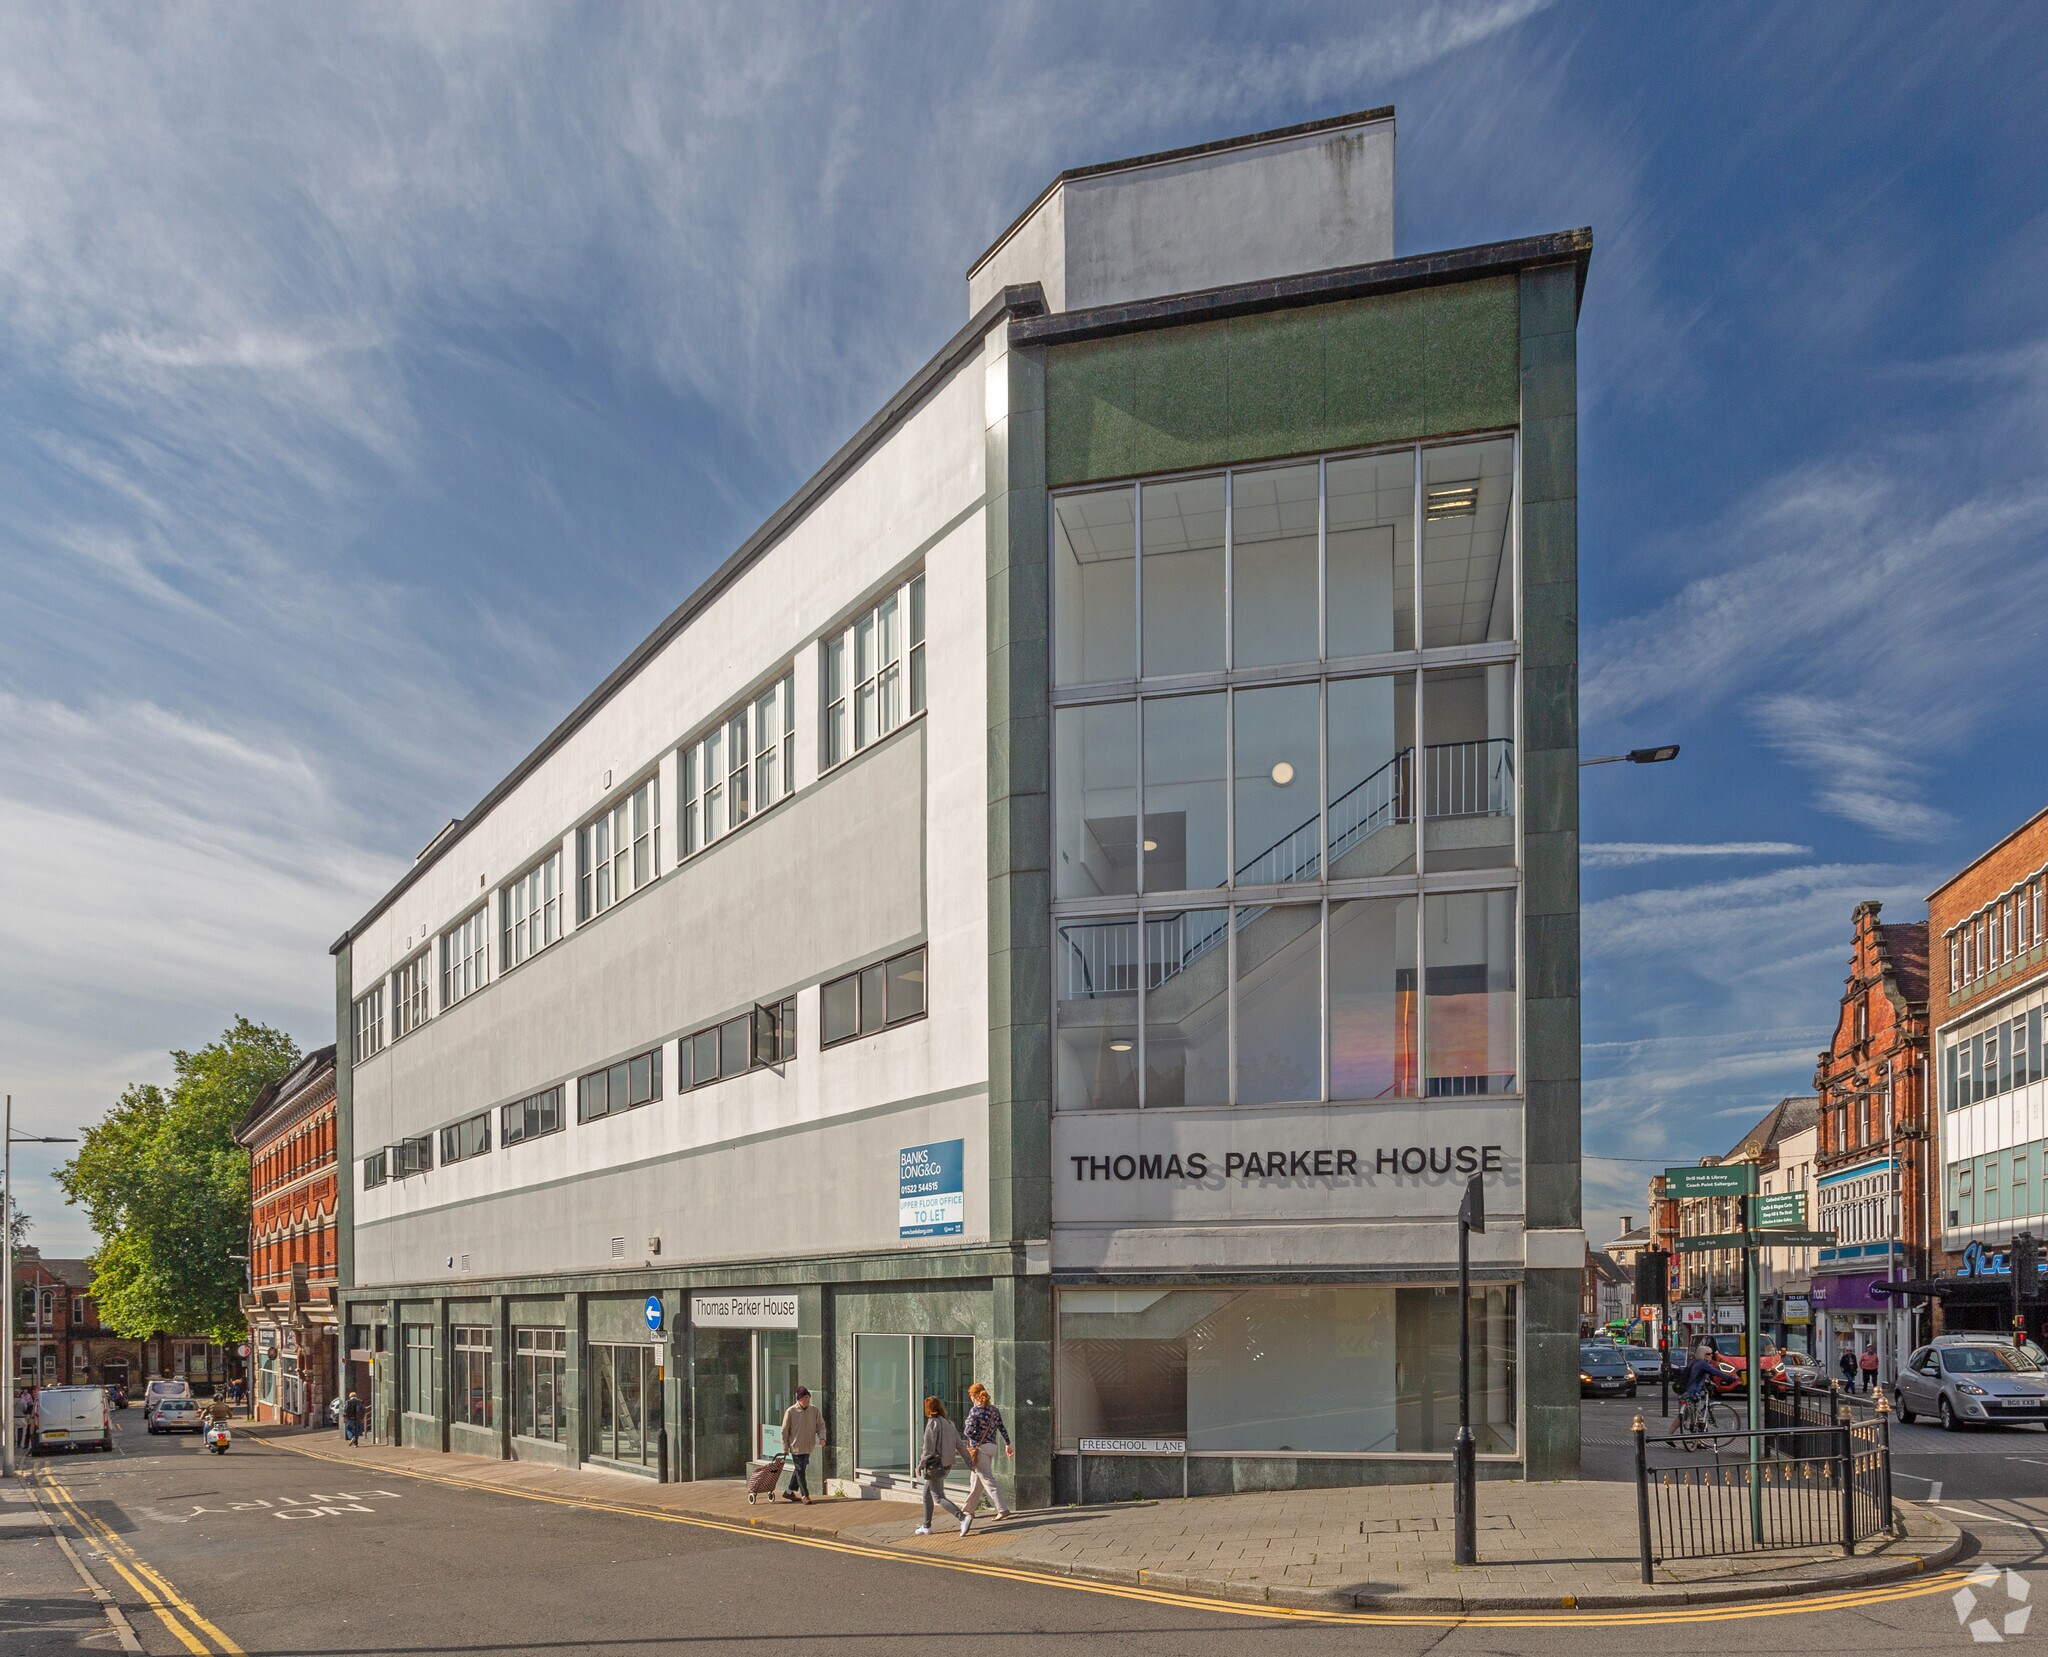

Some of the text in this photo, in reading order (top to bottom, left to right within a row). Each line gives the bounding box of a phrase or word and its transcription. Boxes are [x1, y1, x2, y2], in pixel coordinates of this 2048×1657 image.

[901, 1150, 928, 1166] BANKS
[1071, 1145, 1502, 1181] THOMAS PARKER HOUSE
[901, 1162, 941, 1179] LONG&Co
[901, 1182, 938, 1194] 01522 544515
[900, 1196, 962, 1209] UPPER FLOOR OFFICE
[914, 1209, 945, 1223] TO LET
[695, 1298, 795, 1315] Thomas Parker House
[1082, 1440, 1183, 1451] FREESCHOOL LANE
[190, 1490, 402, 1517] ENTRY
[272, 1503, 375, 1520] NO
